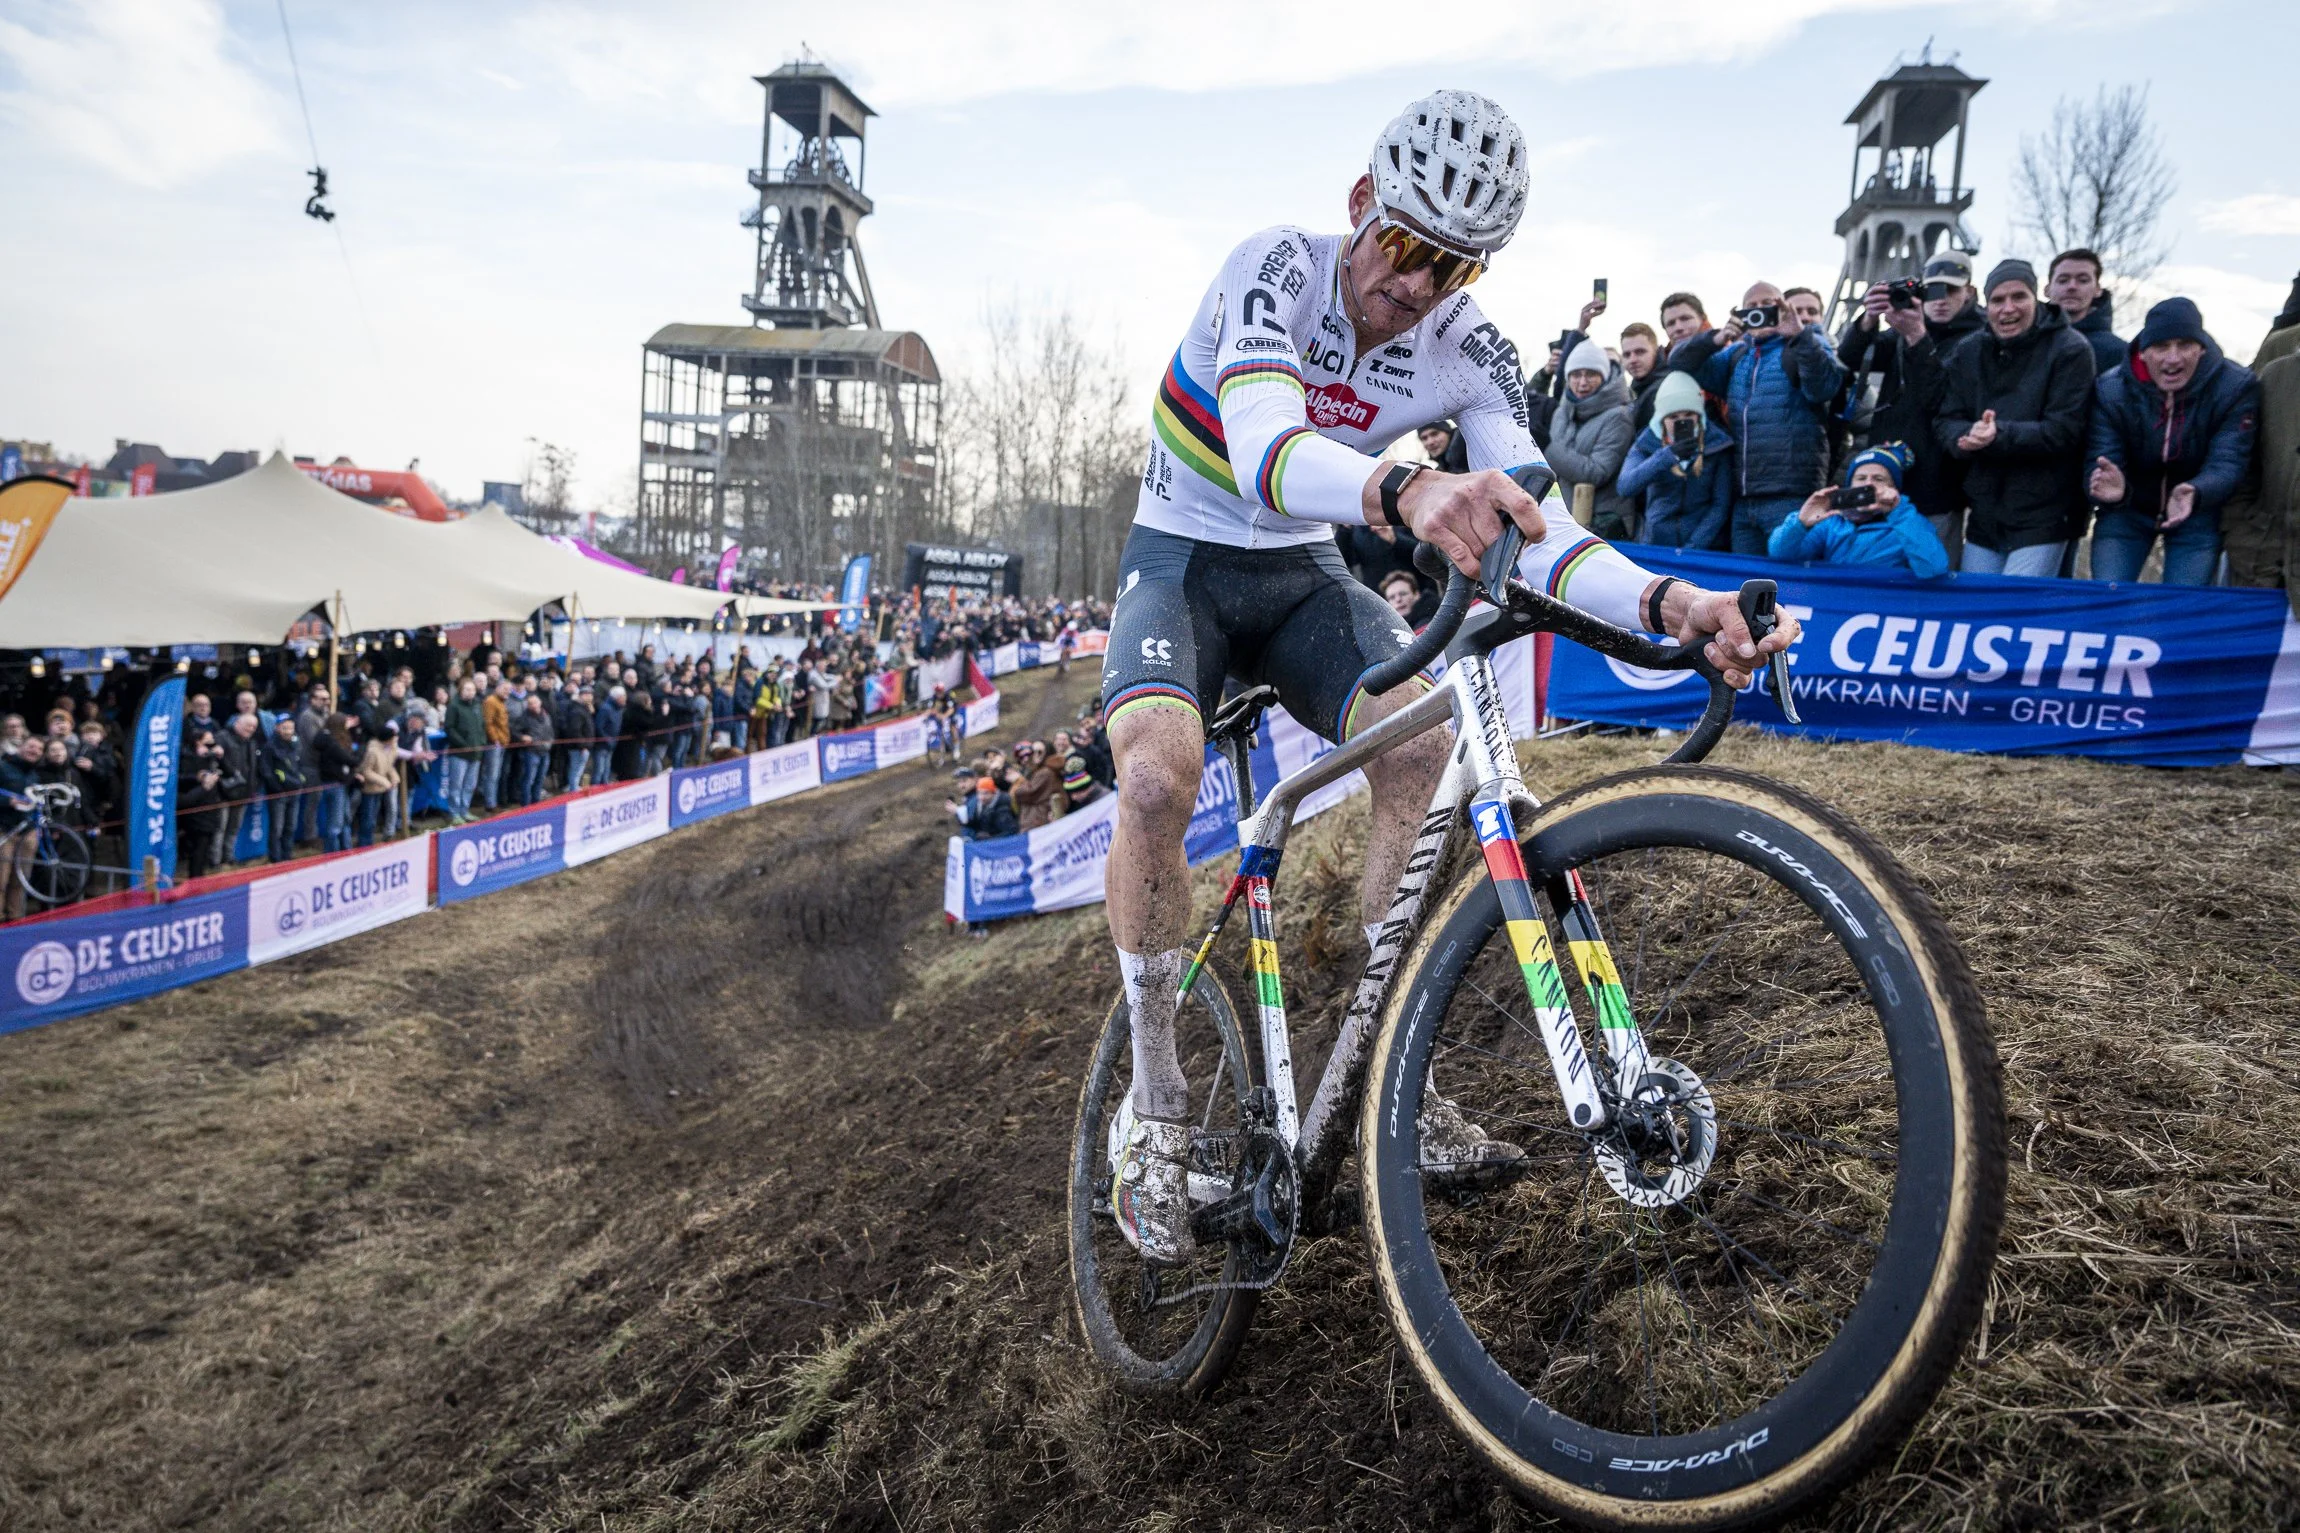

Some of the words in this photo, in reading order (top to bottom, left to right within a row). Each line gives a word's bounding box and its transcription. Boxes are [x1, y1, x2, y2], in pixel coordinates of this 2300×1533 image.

[1242, 339, 1288, 350] ABUS
[1309, 340, 1345, 375] UCI
[1383, 365, 1415, 380] ZWIFT
[1460, 332, 1495, 369] DMG
[1305, 387, 1368, 423] Alpecin
[1366, 376, 1413, 399] CANYON
[1489, 363, 1528, 428] SHAMPOO
[1830, 613, 2162, 698] CEUSTER
[1470, 668, 1503, 763] CANYON
[1738, 670, 1969, 716] OUWKRANEN
[2010, 696, 2147, 731] GRUES
[478, 836, 497, 865] DE
[499, 823, 553, 857] CEUSTER
[312, 882, 334, 914] DE
[340, 860, 409, 903] CEUSTER
[1349, 806, 1456, 1017] CANYON
[1736, 829, 1868, 939] DURA-ACE
[77, 935, 113, 975] DE
[120, 911, 224, 964] CEUSTER
[1531, 934, 1586, 1085] CANYON
[1390, 989, 1429, 1138] DURA-ACE
[1608, 1427, 1769, 1472] DURA-ACE
